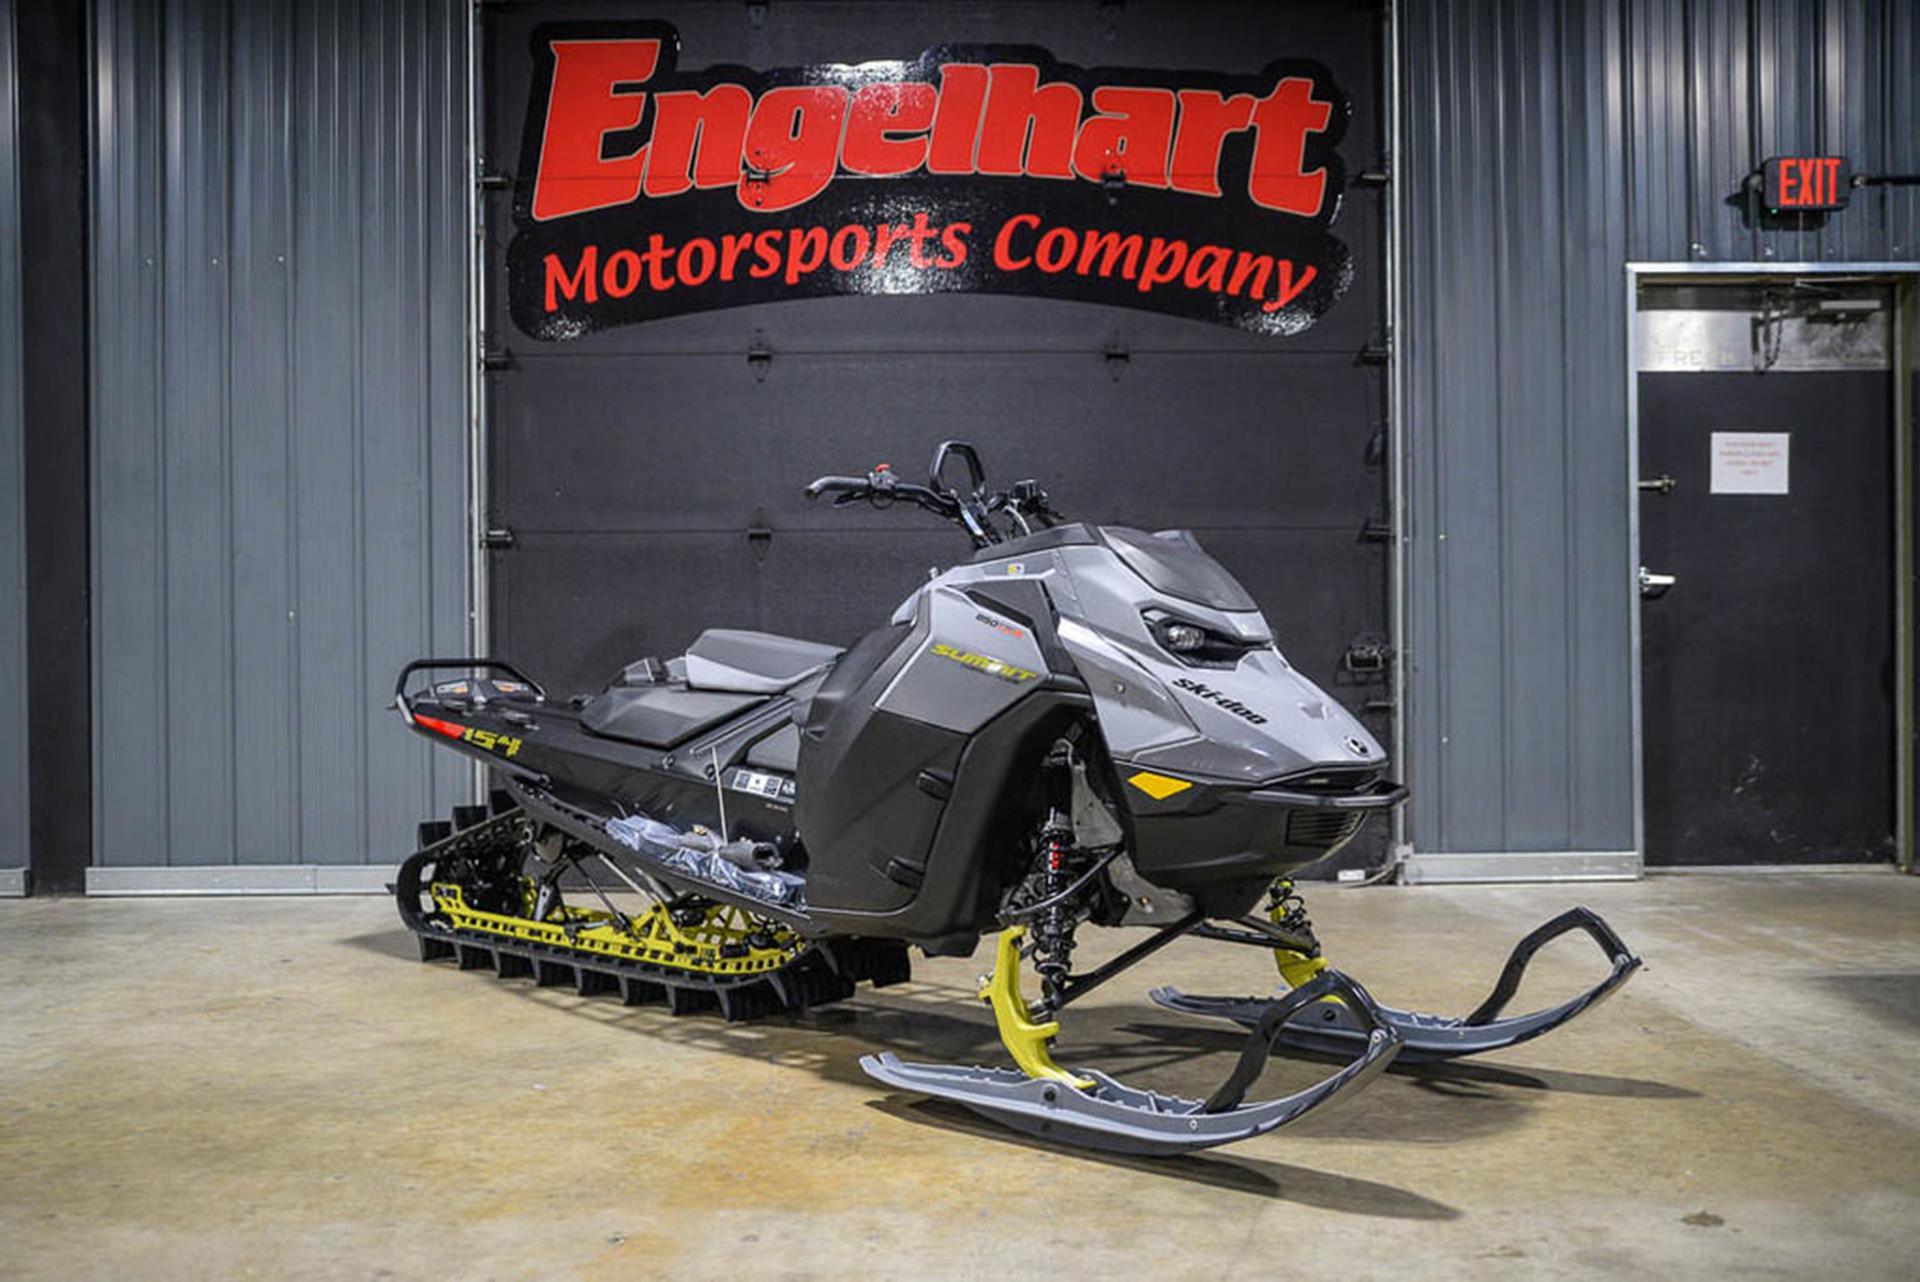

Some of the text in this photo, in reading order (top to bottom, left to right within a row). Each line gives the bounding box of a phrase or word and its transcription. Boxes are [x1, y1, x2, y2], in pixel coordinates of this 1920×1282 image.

[531, 39, 1332, 219] Engelhart
[1778, 157, 1841, 207] EXIT
[544, 213, 1318, 313] Motorsports Company
[463, 728, 522, 757] 154
